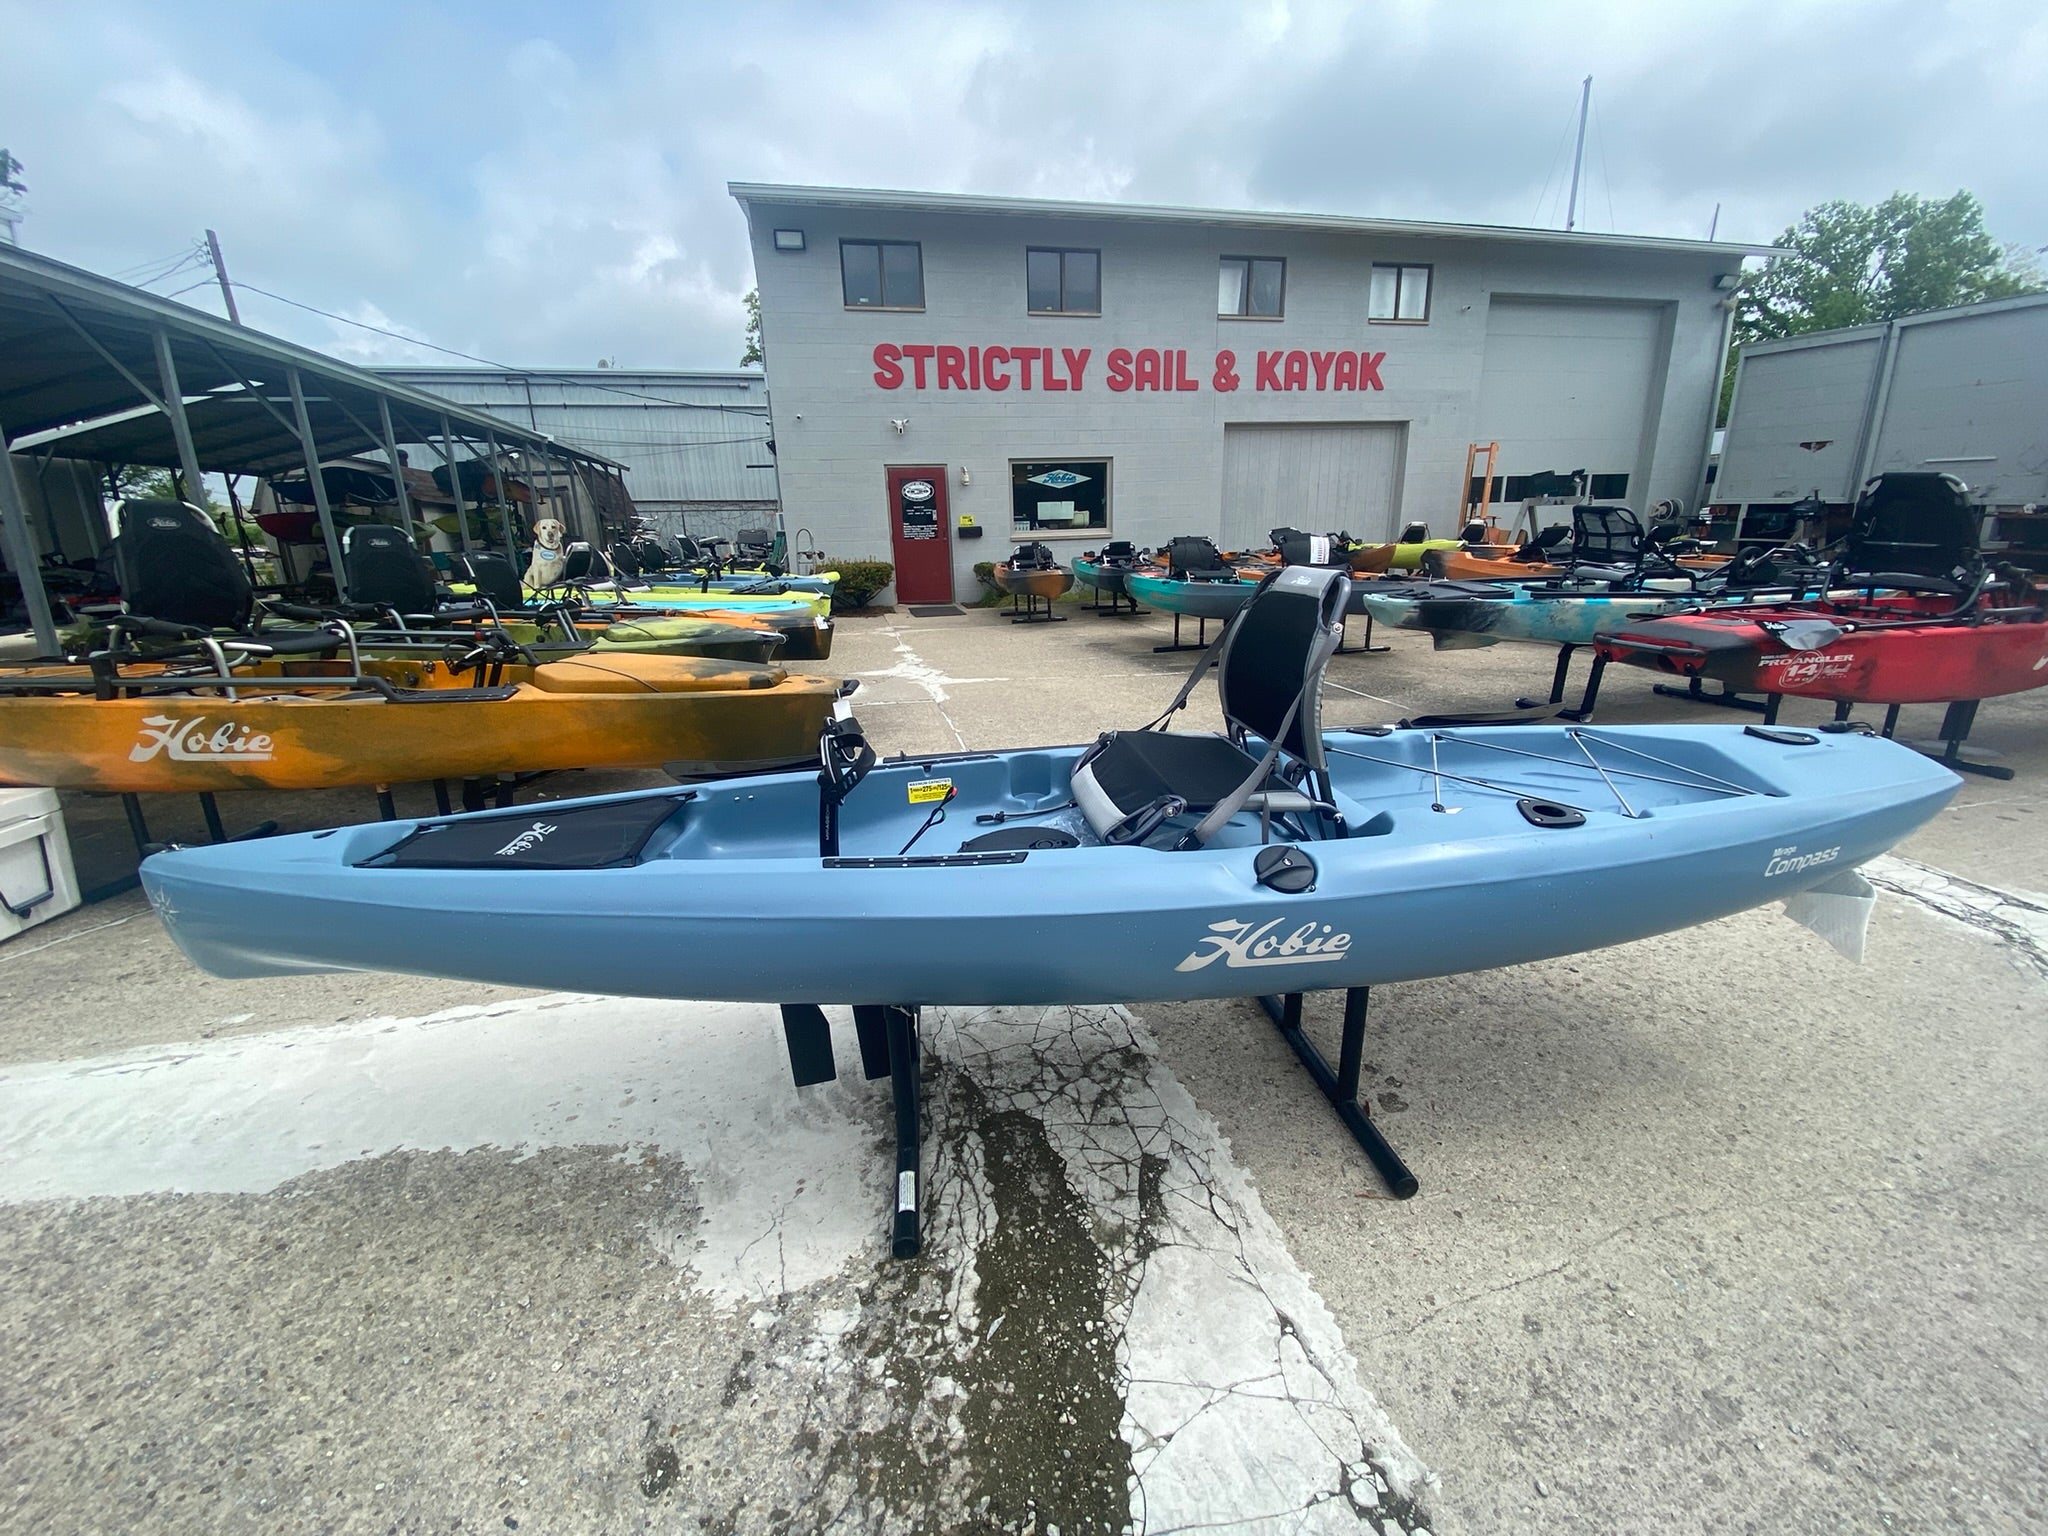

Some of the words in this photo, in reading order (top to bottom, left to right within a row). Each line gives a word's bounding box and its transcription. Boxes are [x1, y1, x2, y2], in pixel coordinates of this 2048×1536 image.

[873, 343, 1092, 391] STRICTLY
[1106, 348, 1199, 392] SAIL
[1212, 350, 1240, 392] &
[1256, 351, 1386, 392] KAYAK
[1788, 664, 1818, 677] 14
[128, 715, 274, 763] Hobie
[494, 822, 558, 856] Hobie
[1772, 846, 1797, 857] Mirage
[1764, 846, 1841, 877] Compass
[1174, 917, 1352, 972] Hobie
